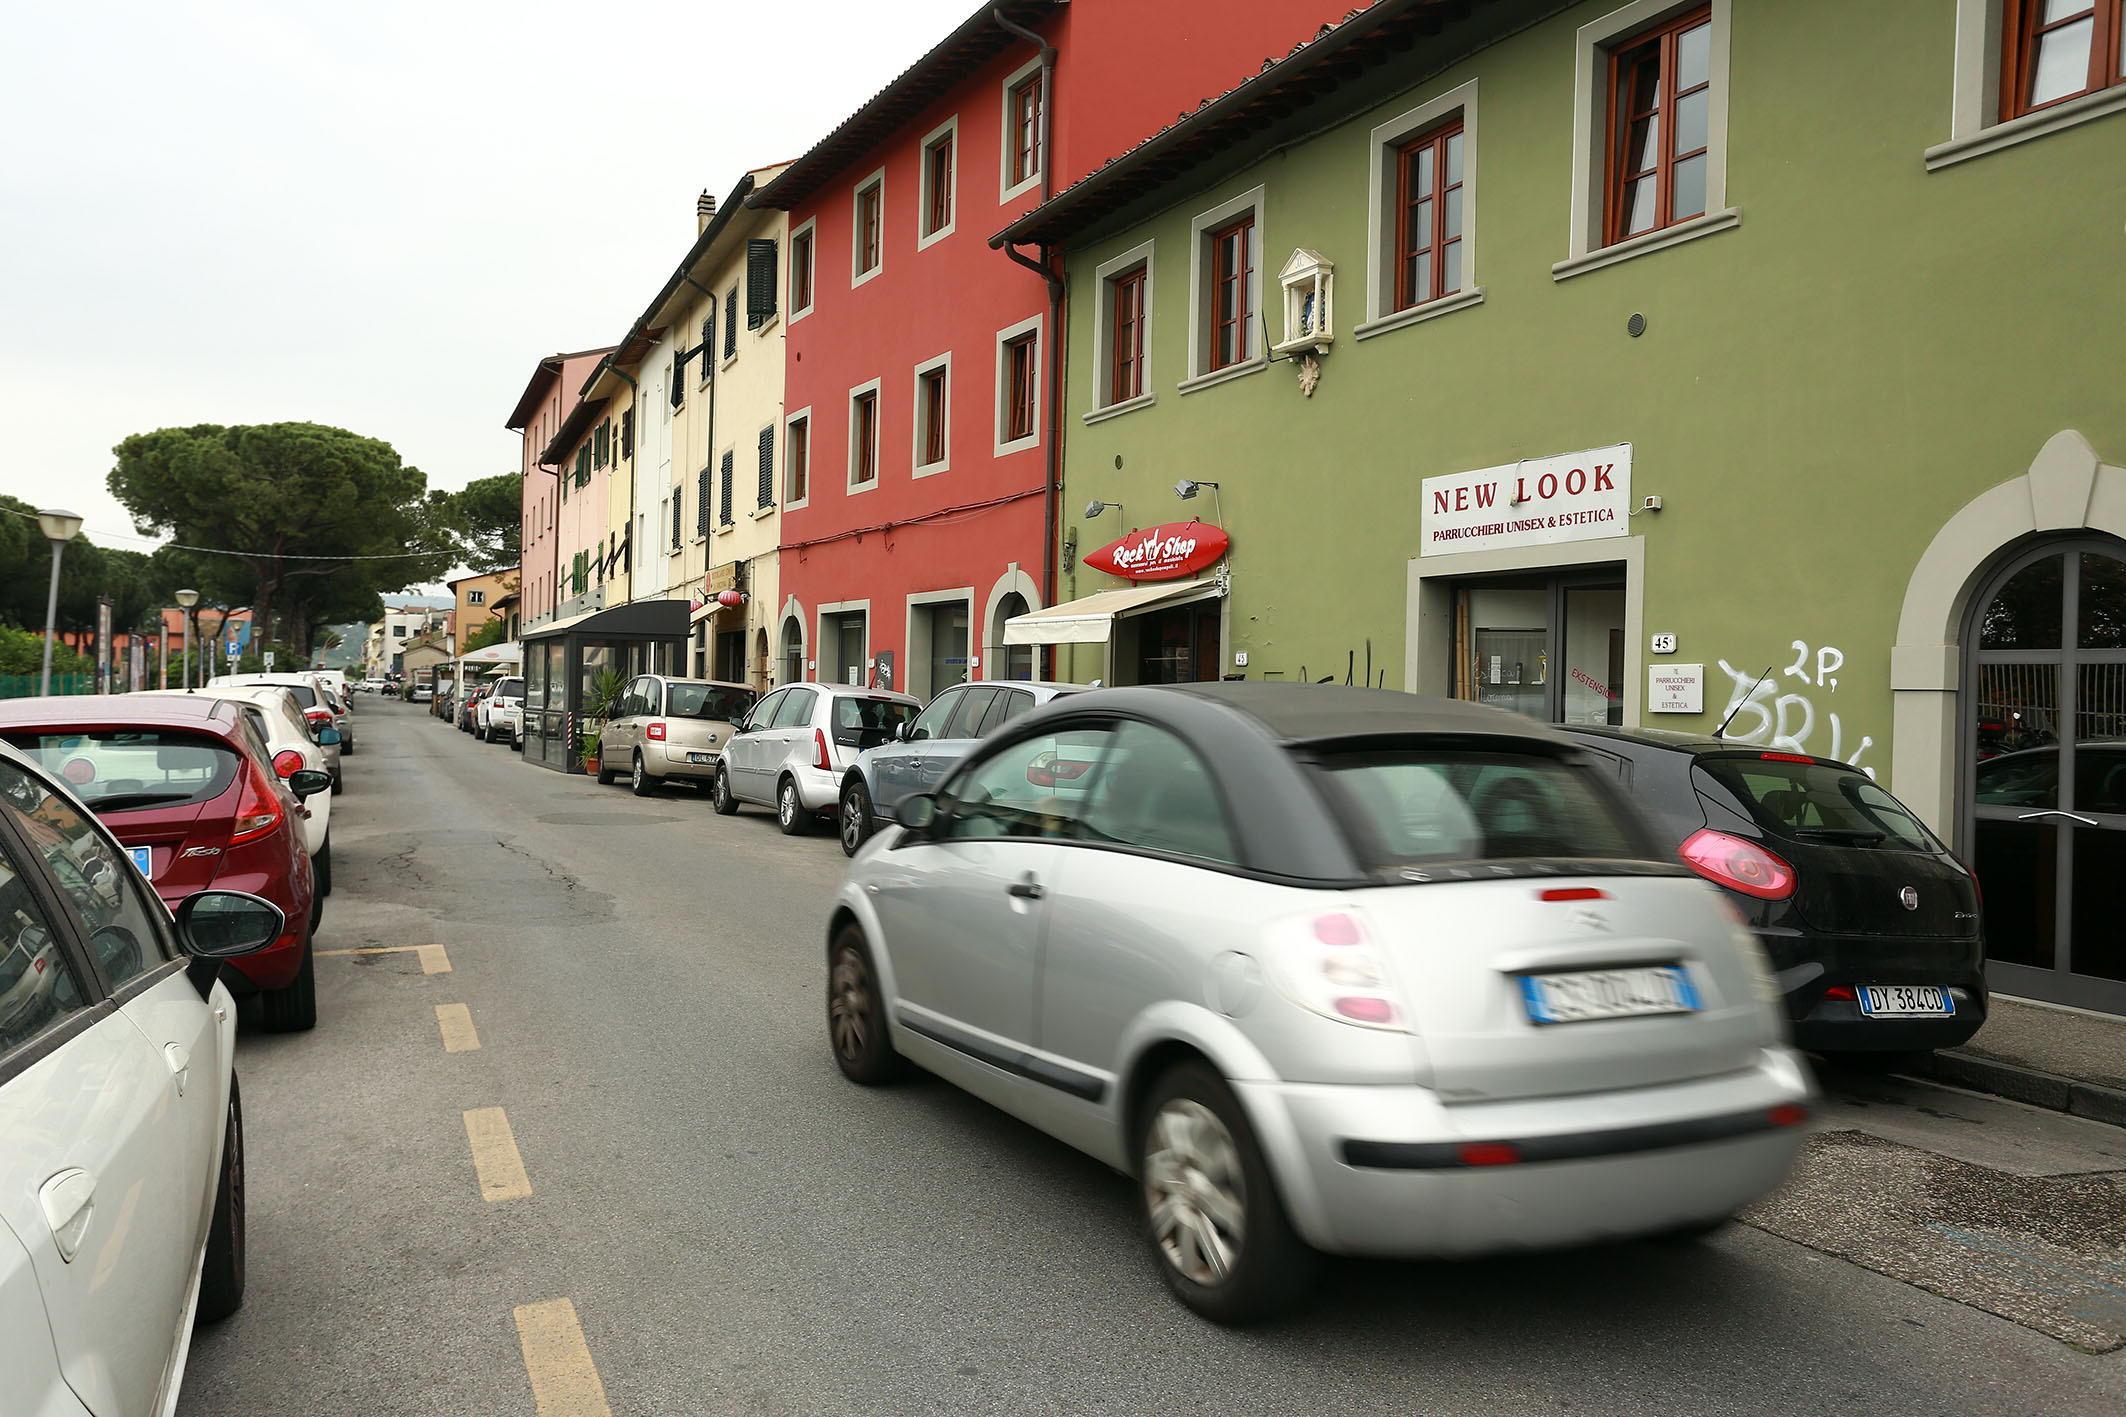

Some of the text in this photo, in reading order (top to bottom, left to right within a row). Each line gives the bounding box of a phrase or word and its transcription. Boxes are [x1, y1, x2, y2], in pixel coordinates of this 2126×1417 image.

[1433, 463, 1614, 514] NEW LOOK
[1433, 508, 1614, 541] PARRUCCHIERI UNISEX & ESTETICA
[1112, 543, 1145, 569] Rock
[1162, 536, 1196, 558] Shop
[229, 642, 238, 654] P
[1870, 987, 1943, 1010] DY 384CD
